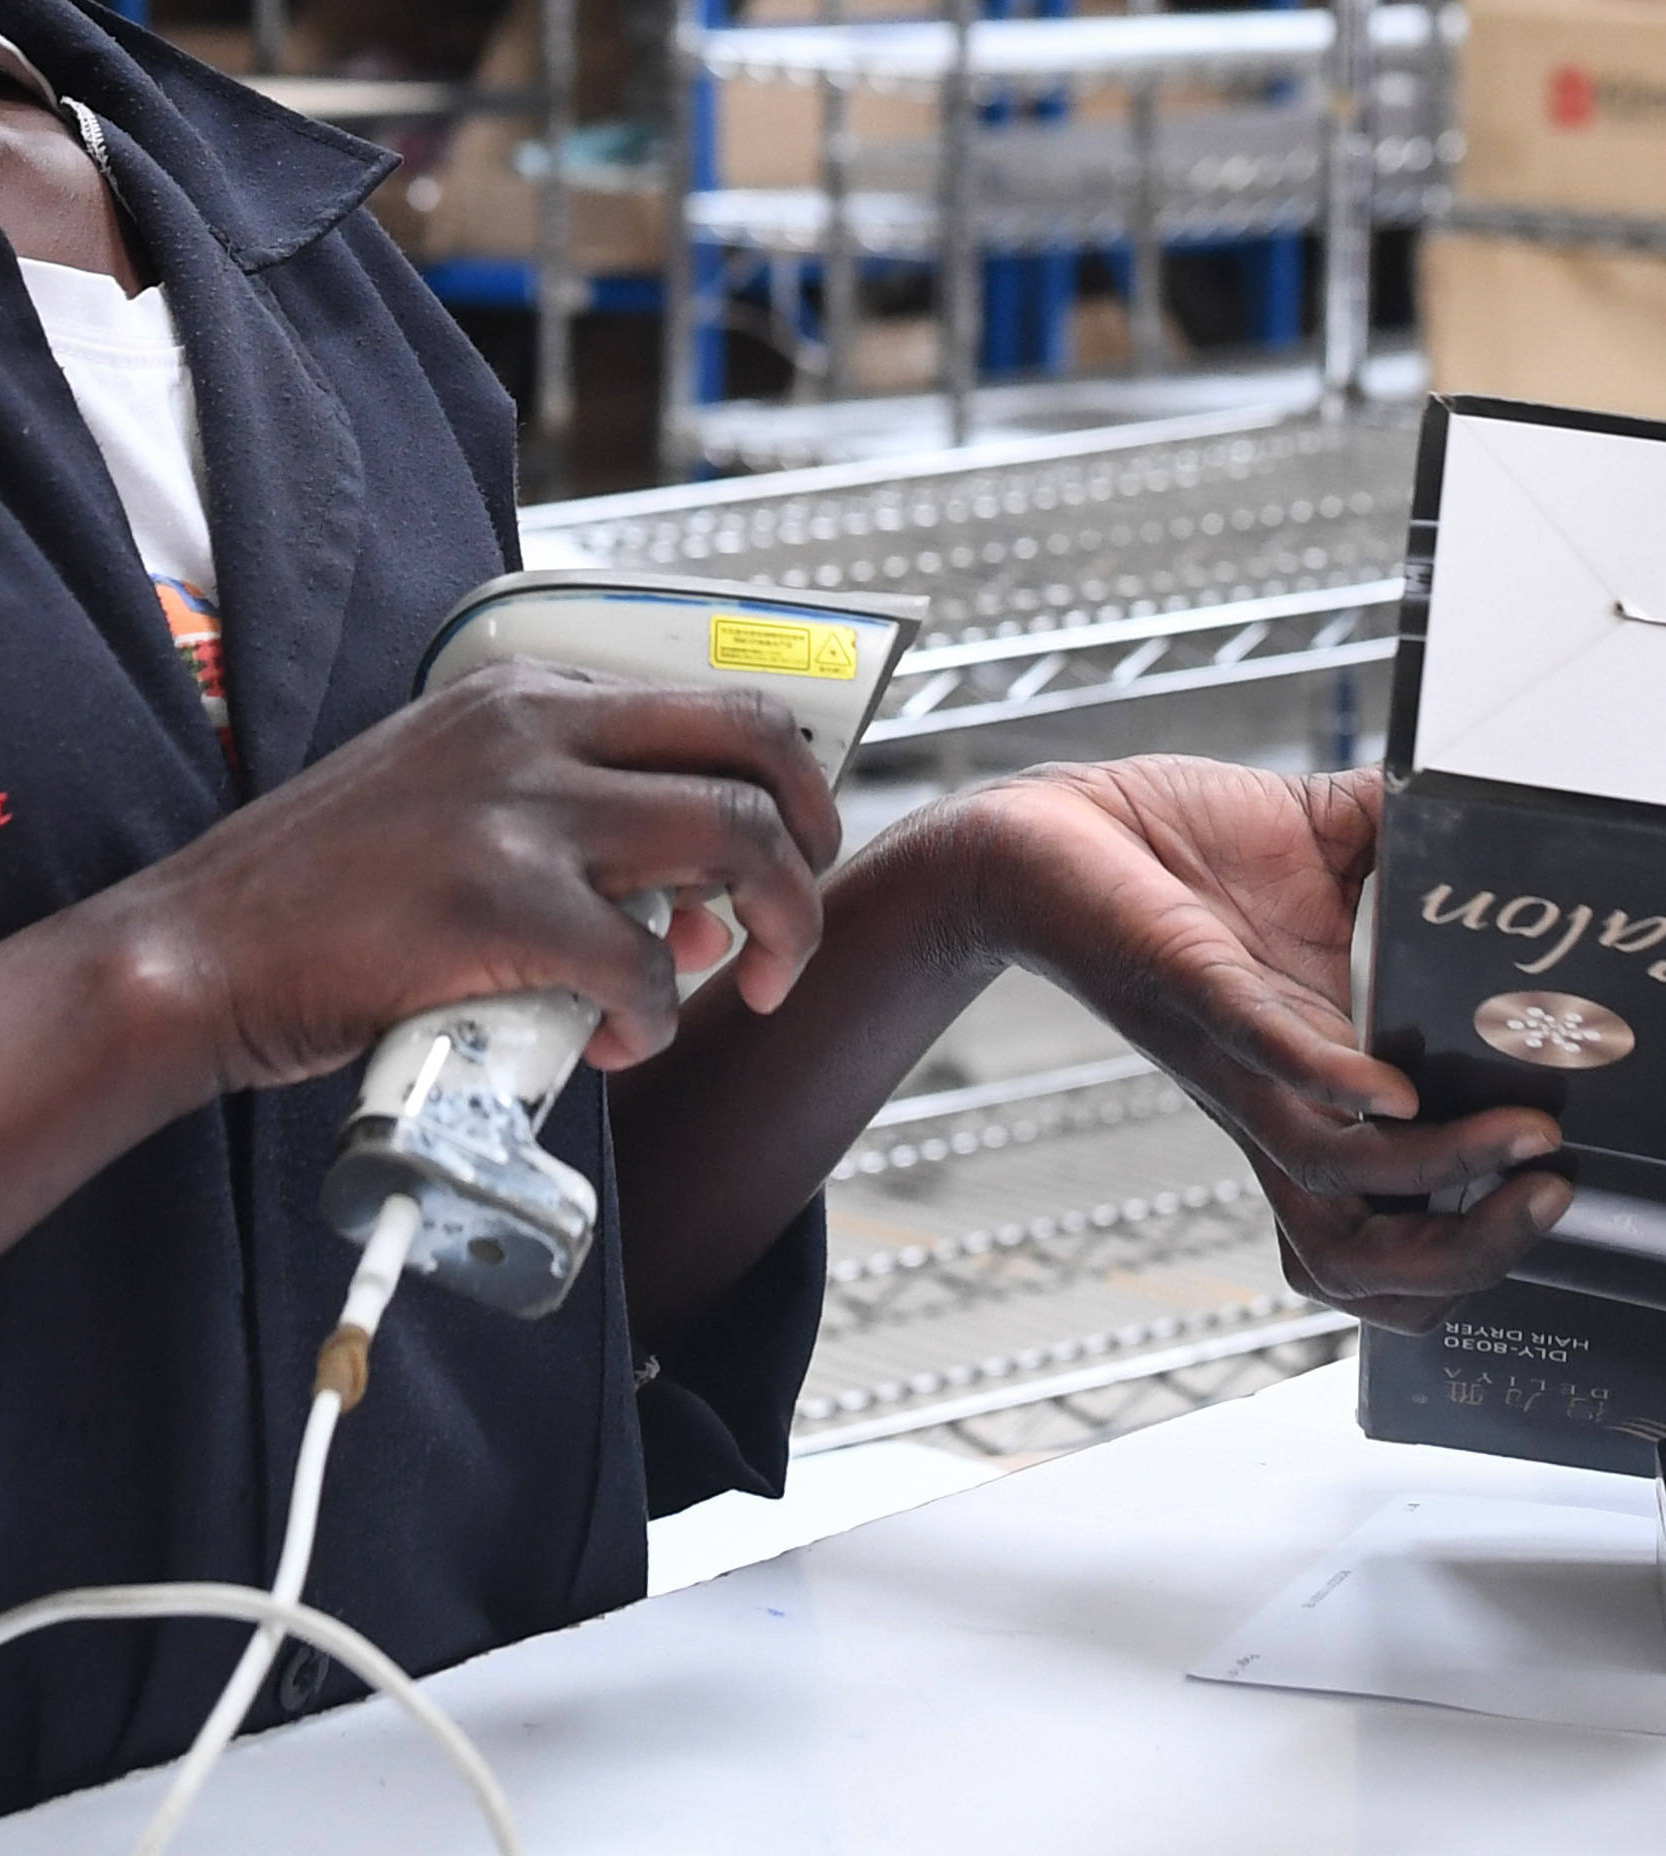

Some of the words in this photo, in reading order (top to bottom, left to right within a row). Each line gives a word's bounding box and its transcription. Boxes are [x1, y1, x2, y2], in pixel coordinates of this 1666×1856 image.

[1444, 1320, 1523, 1342] DRYER
[1531, 1331, 1590, 1351] HAIR
[1443, 1335, 1568, 1363] DLY-8030
[1442, 1367, 1610, 1400] DELIYA
